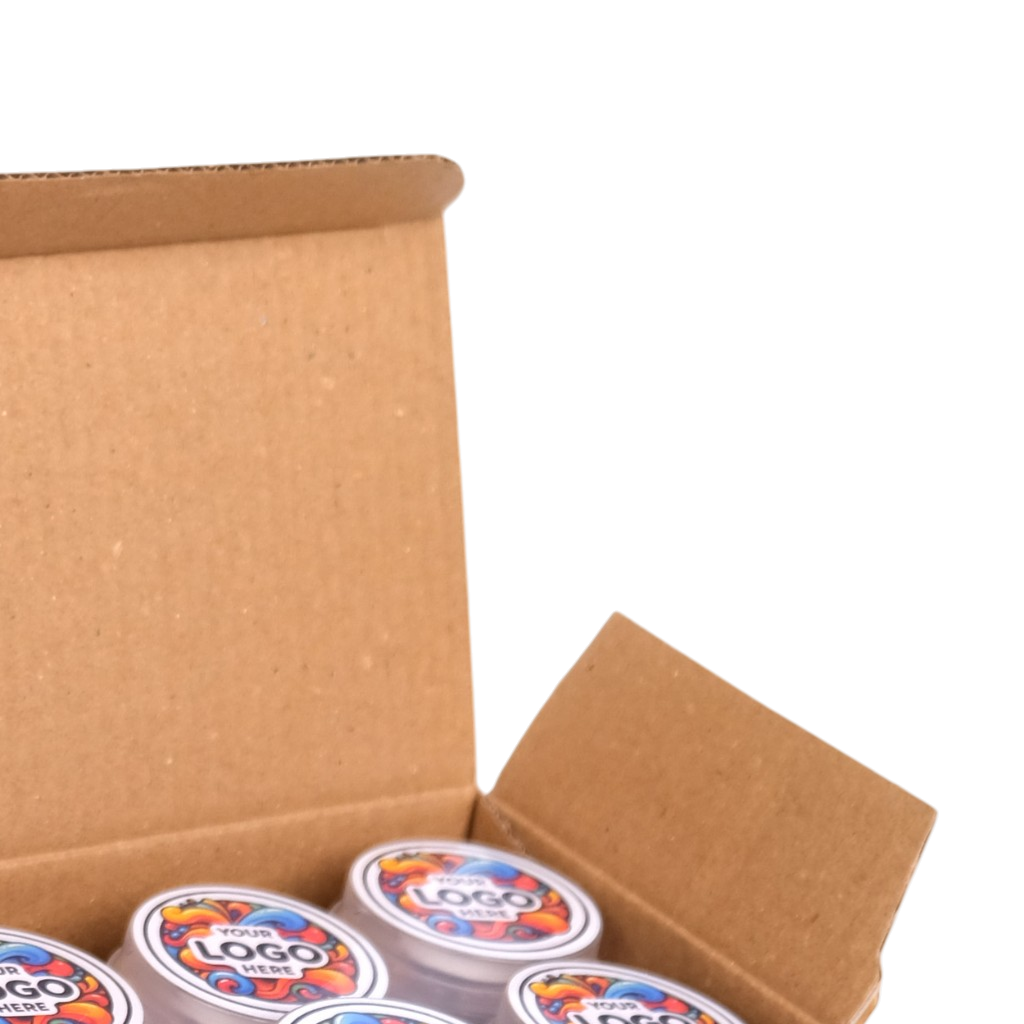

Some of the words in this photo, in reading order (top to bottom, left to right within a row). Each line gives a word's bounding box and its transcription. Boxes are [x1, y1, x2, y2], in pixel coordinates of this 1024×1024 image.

[412, 888, 536, 907] LOGO
[216, 927, 272, 938] YOUR
[194, 941, 322, 963] LOGO
[242, 964, 295, 975] HERE
[588, 1002, 639, 1010] YOUR
